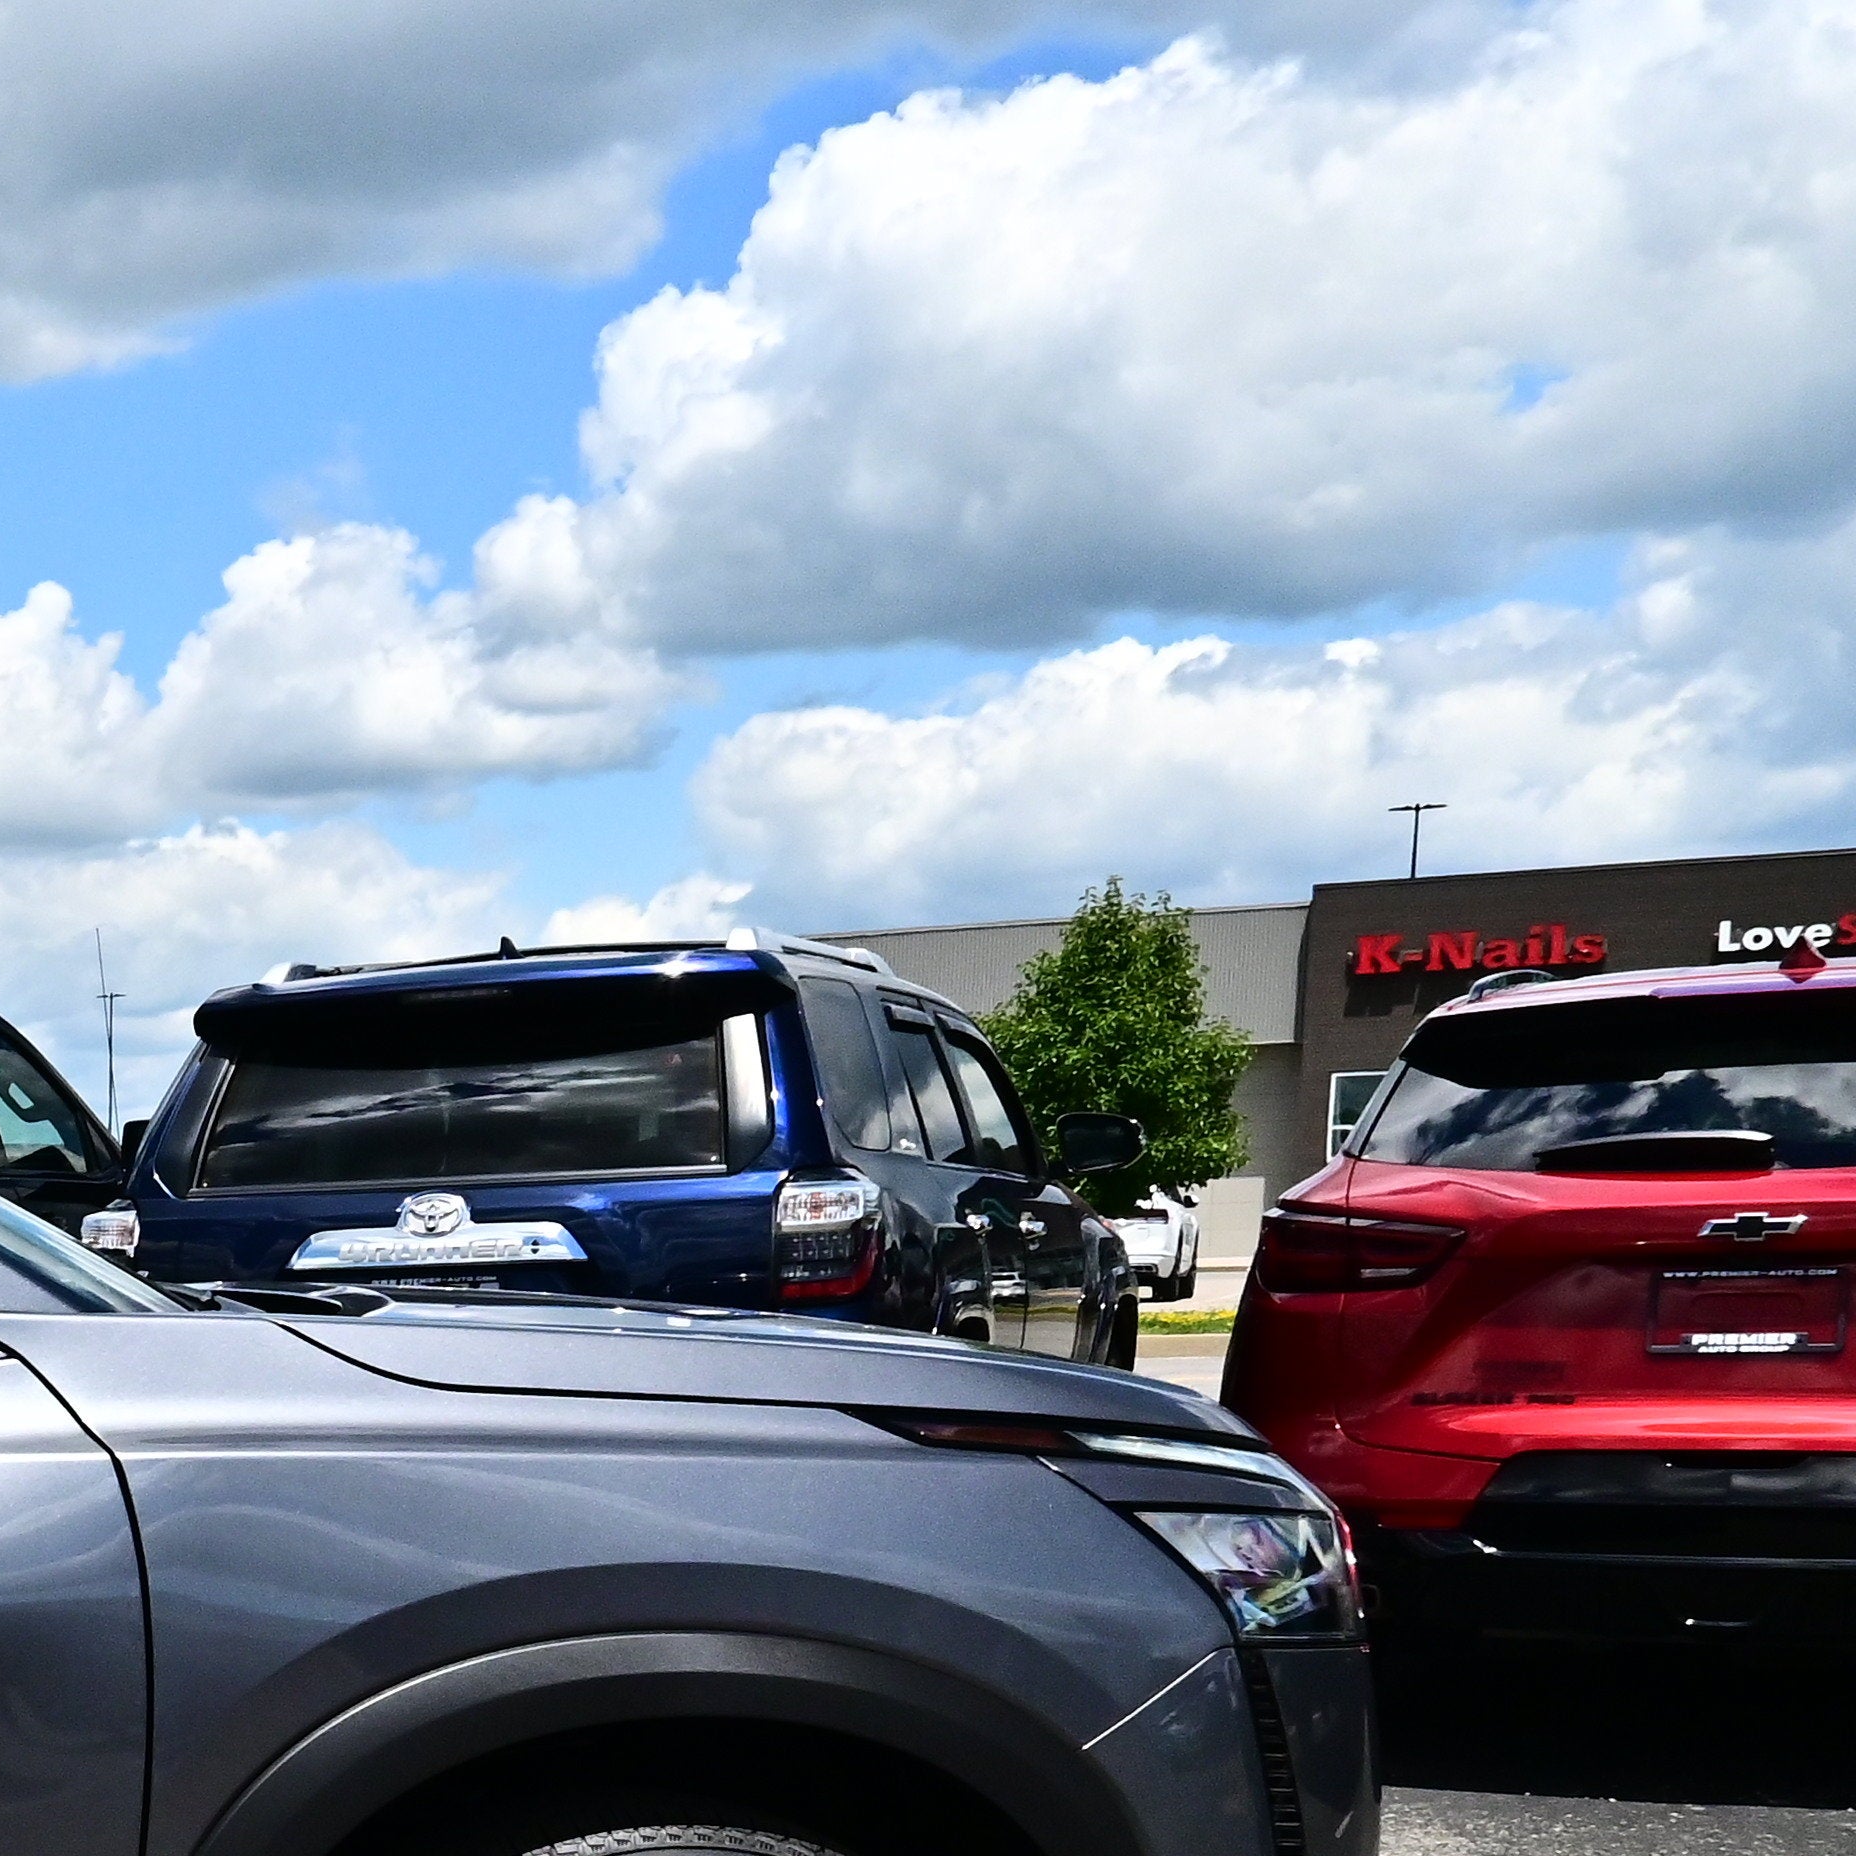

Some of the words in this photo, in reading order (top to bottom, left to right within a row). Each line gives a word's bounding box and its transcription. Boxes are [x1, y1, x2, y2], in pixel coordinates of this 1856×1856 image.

[1355, 924, 1605, 974] K-Nails
[1691, 1333, 1797, 1345] PREMIER
[1698, 1345, 1738, 1353] AUTO
